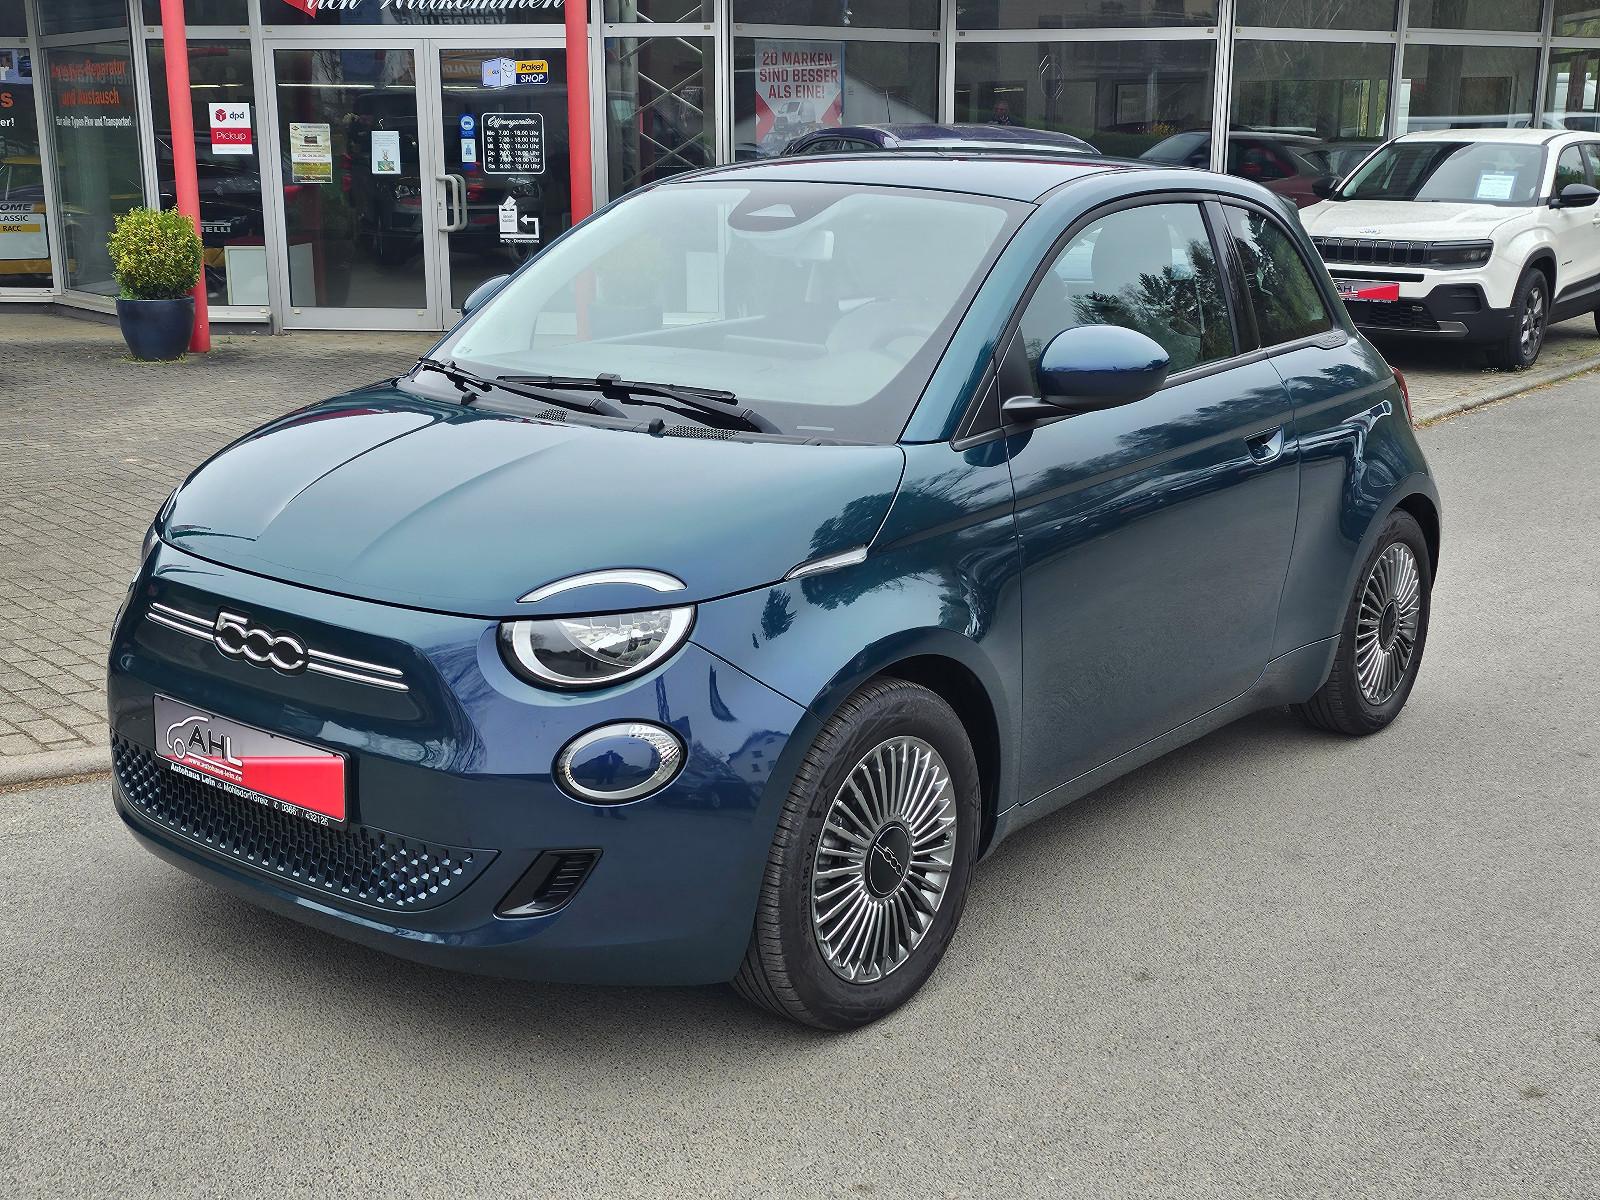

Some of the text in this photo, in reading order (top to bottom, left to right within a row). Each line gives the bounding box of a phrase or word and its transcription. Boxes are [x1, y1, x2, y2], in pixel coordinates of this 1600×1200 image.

[762, 51, 833, 66] 20 MARKEN
[520, 63, 545, 71] Paket
[520, 73, 545, 83] SHOP
[760, 68, 839, 83] SIND BESSER
[768, 85, 825, 99] ALS EINE!
[229, 111, 245, 121] dpd
[216, 131, 247, 142] Pickup
[214, 609, 306, 671] 500
[187, 724, 243, 767] AHL
[170, 762, 201, 781] Autohaus
[201, 774, 216, 787] Lein
